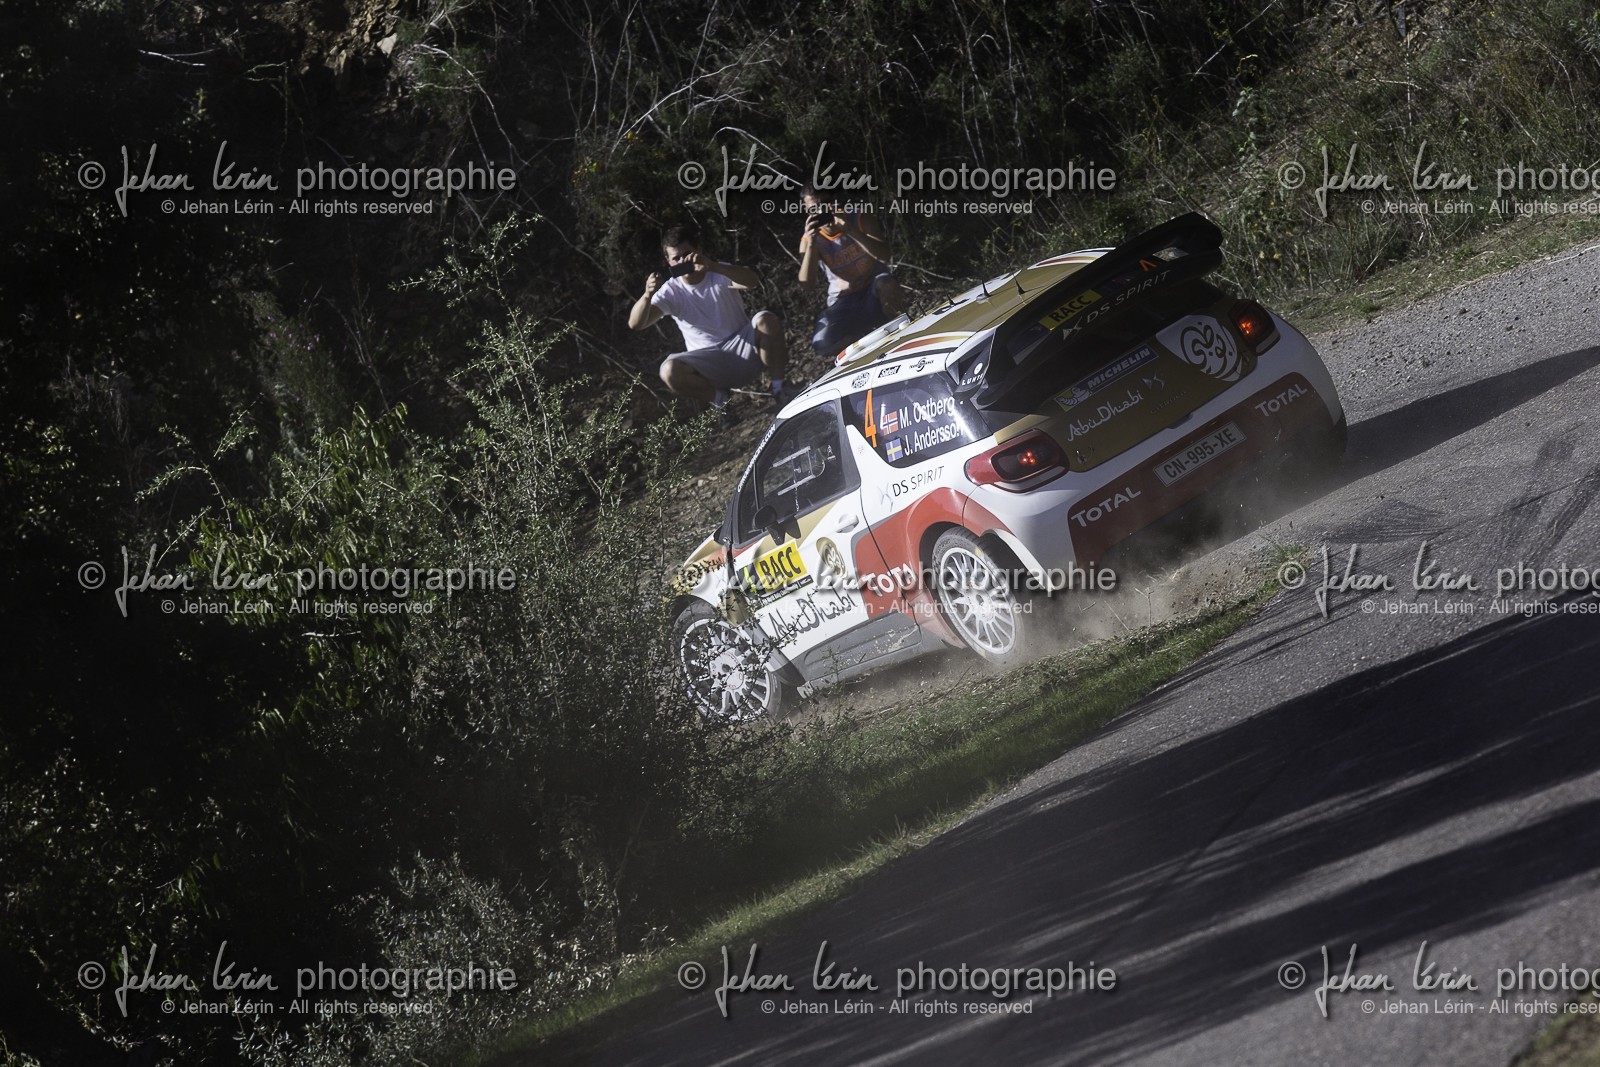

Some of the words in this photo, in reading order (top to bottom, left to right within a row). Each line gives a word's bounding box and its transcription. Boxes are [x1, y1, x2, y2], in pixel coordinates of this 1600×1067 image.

[1049, 295, 1092, 323] RACC
[1086, 302, 1110, 324] DS
[1115, 269, 1171, 306] SPIRIT
[1087, 347, 1150, 389] MICHELIN
[865, 389, 877, 448] 4
[899, 406, 912, 429] M.
[1254, 384, 1308, 417] TOTAL
[904, 434, 913, 456] J.
[1163, 426, 1237, 479] CN-995-XE
[892, 479, 909, 497] DS
[910, 465, 945, 490] SPIRIT
[1071, 487, 1141, 527] TOTAL
[759, 546, 802, 586] RACC
